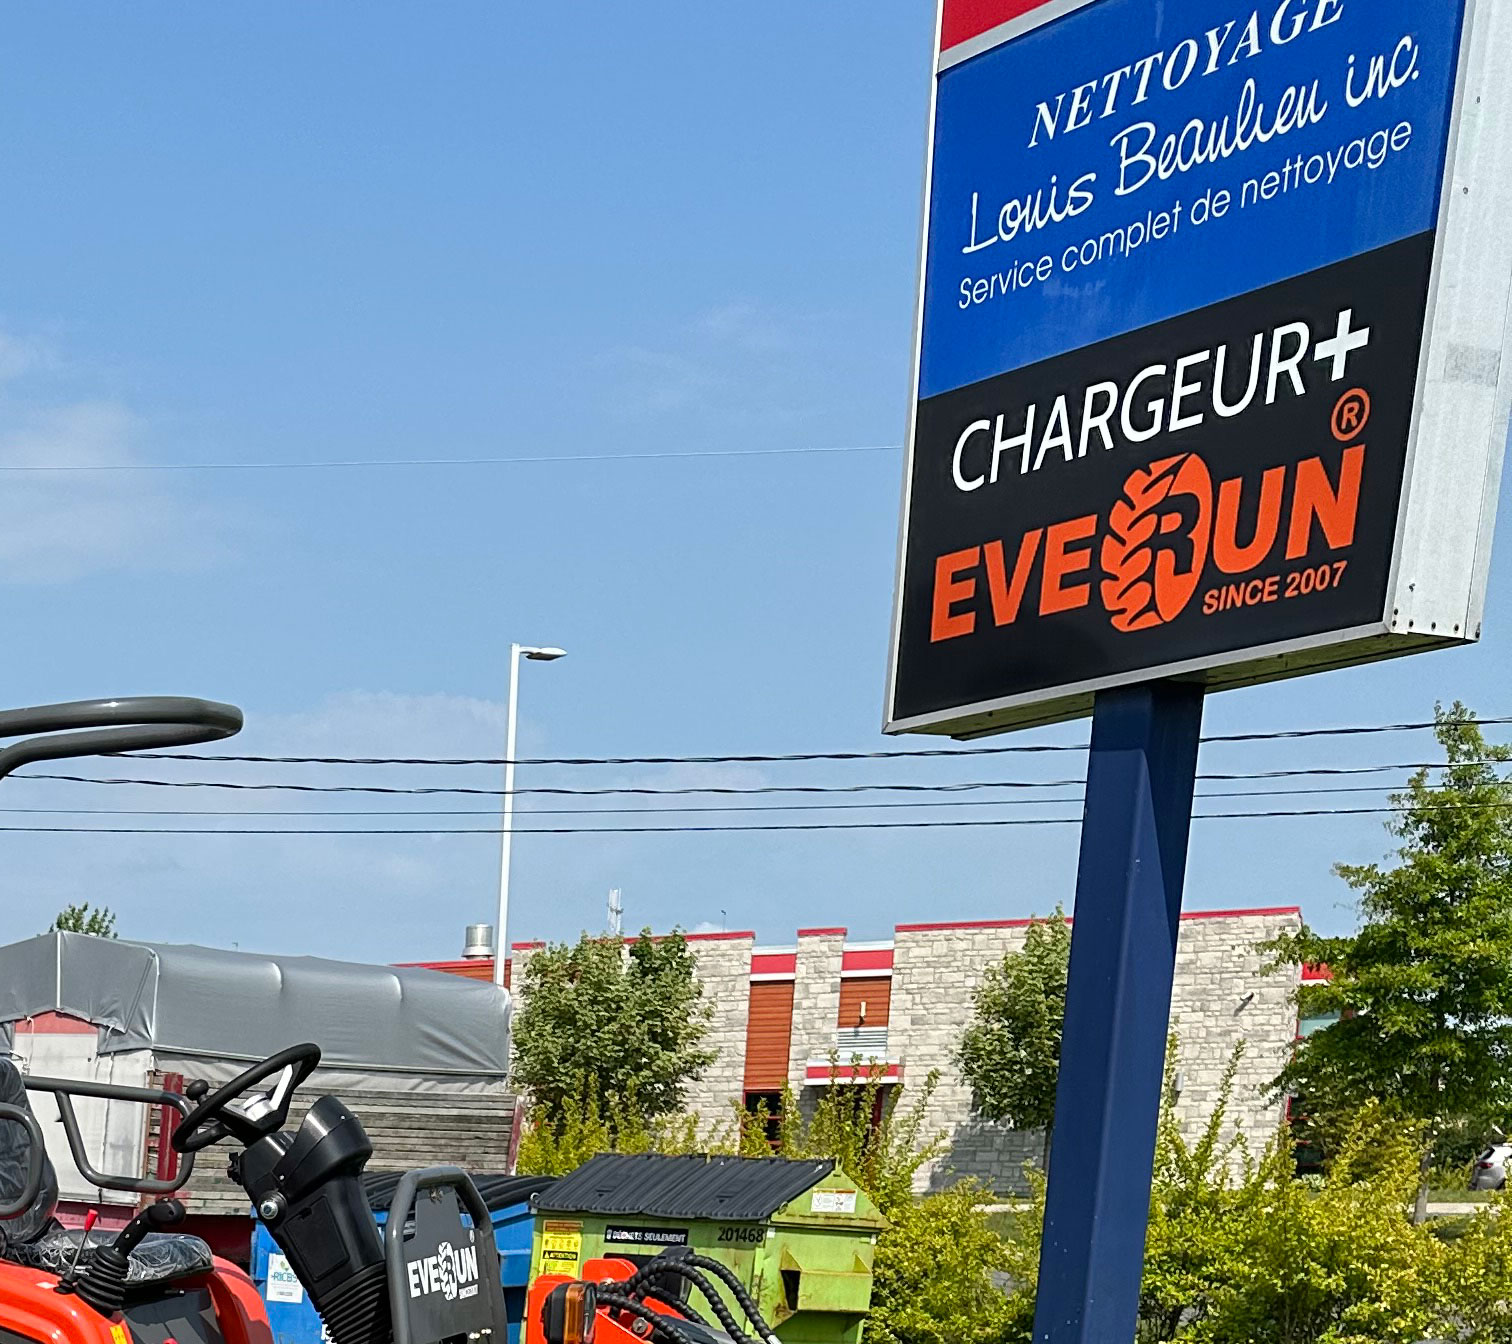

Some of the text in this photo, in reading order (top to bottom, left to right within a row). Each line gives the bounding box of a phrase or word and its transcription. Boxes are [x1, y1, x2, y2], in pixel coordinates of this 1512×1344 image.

[962, 36, 1420, 255] Louis Beaulieu inc.
[1028, 0, 1347, 149] NETTOYAGE
[958, 121, 1412, 309] Service complet de nettoyage
[952, 308, 1370, 492] CHARGEUR+
[1202, 560, 1348, 615] SINCE 2007
[717, 1227, 764, 1243] 201468
